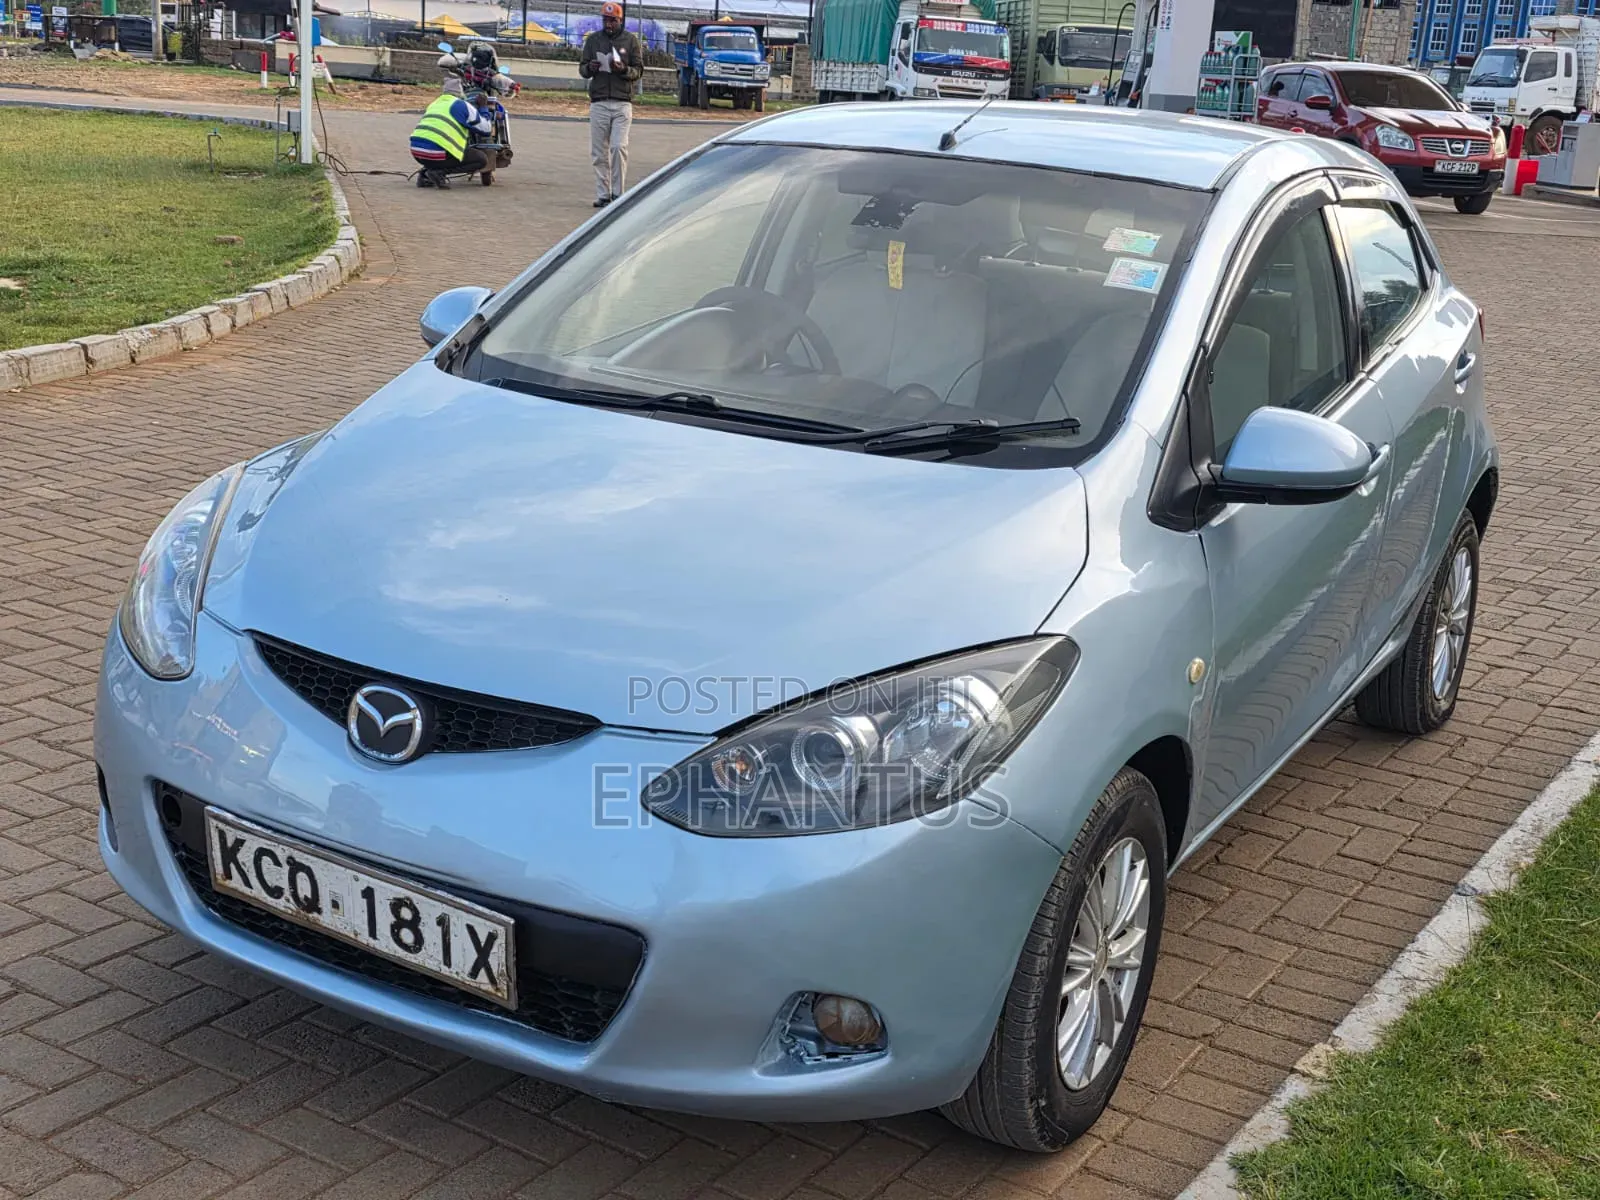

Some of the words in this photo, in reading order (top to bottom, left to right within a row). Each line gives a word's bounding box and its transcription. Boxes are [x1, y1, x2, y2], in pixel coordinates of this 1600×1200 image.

[951, 70, 976, 78] ISUZU
[216, 827, 323, 915] KCQ
[361, 885, 499, 987] 181X
